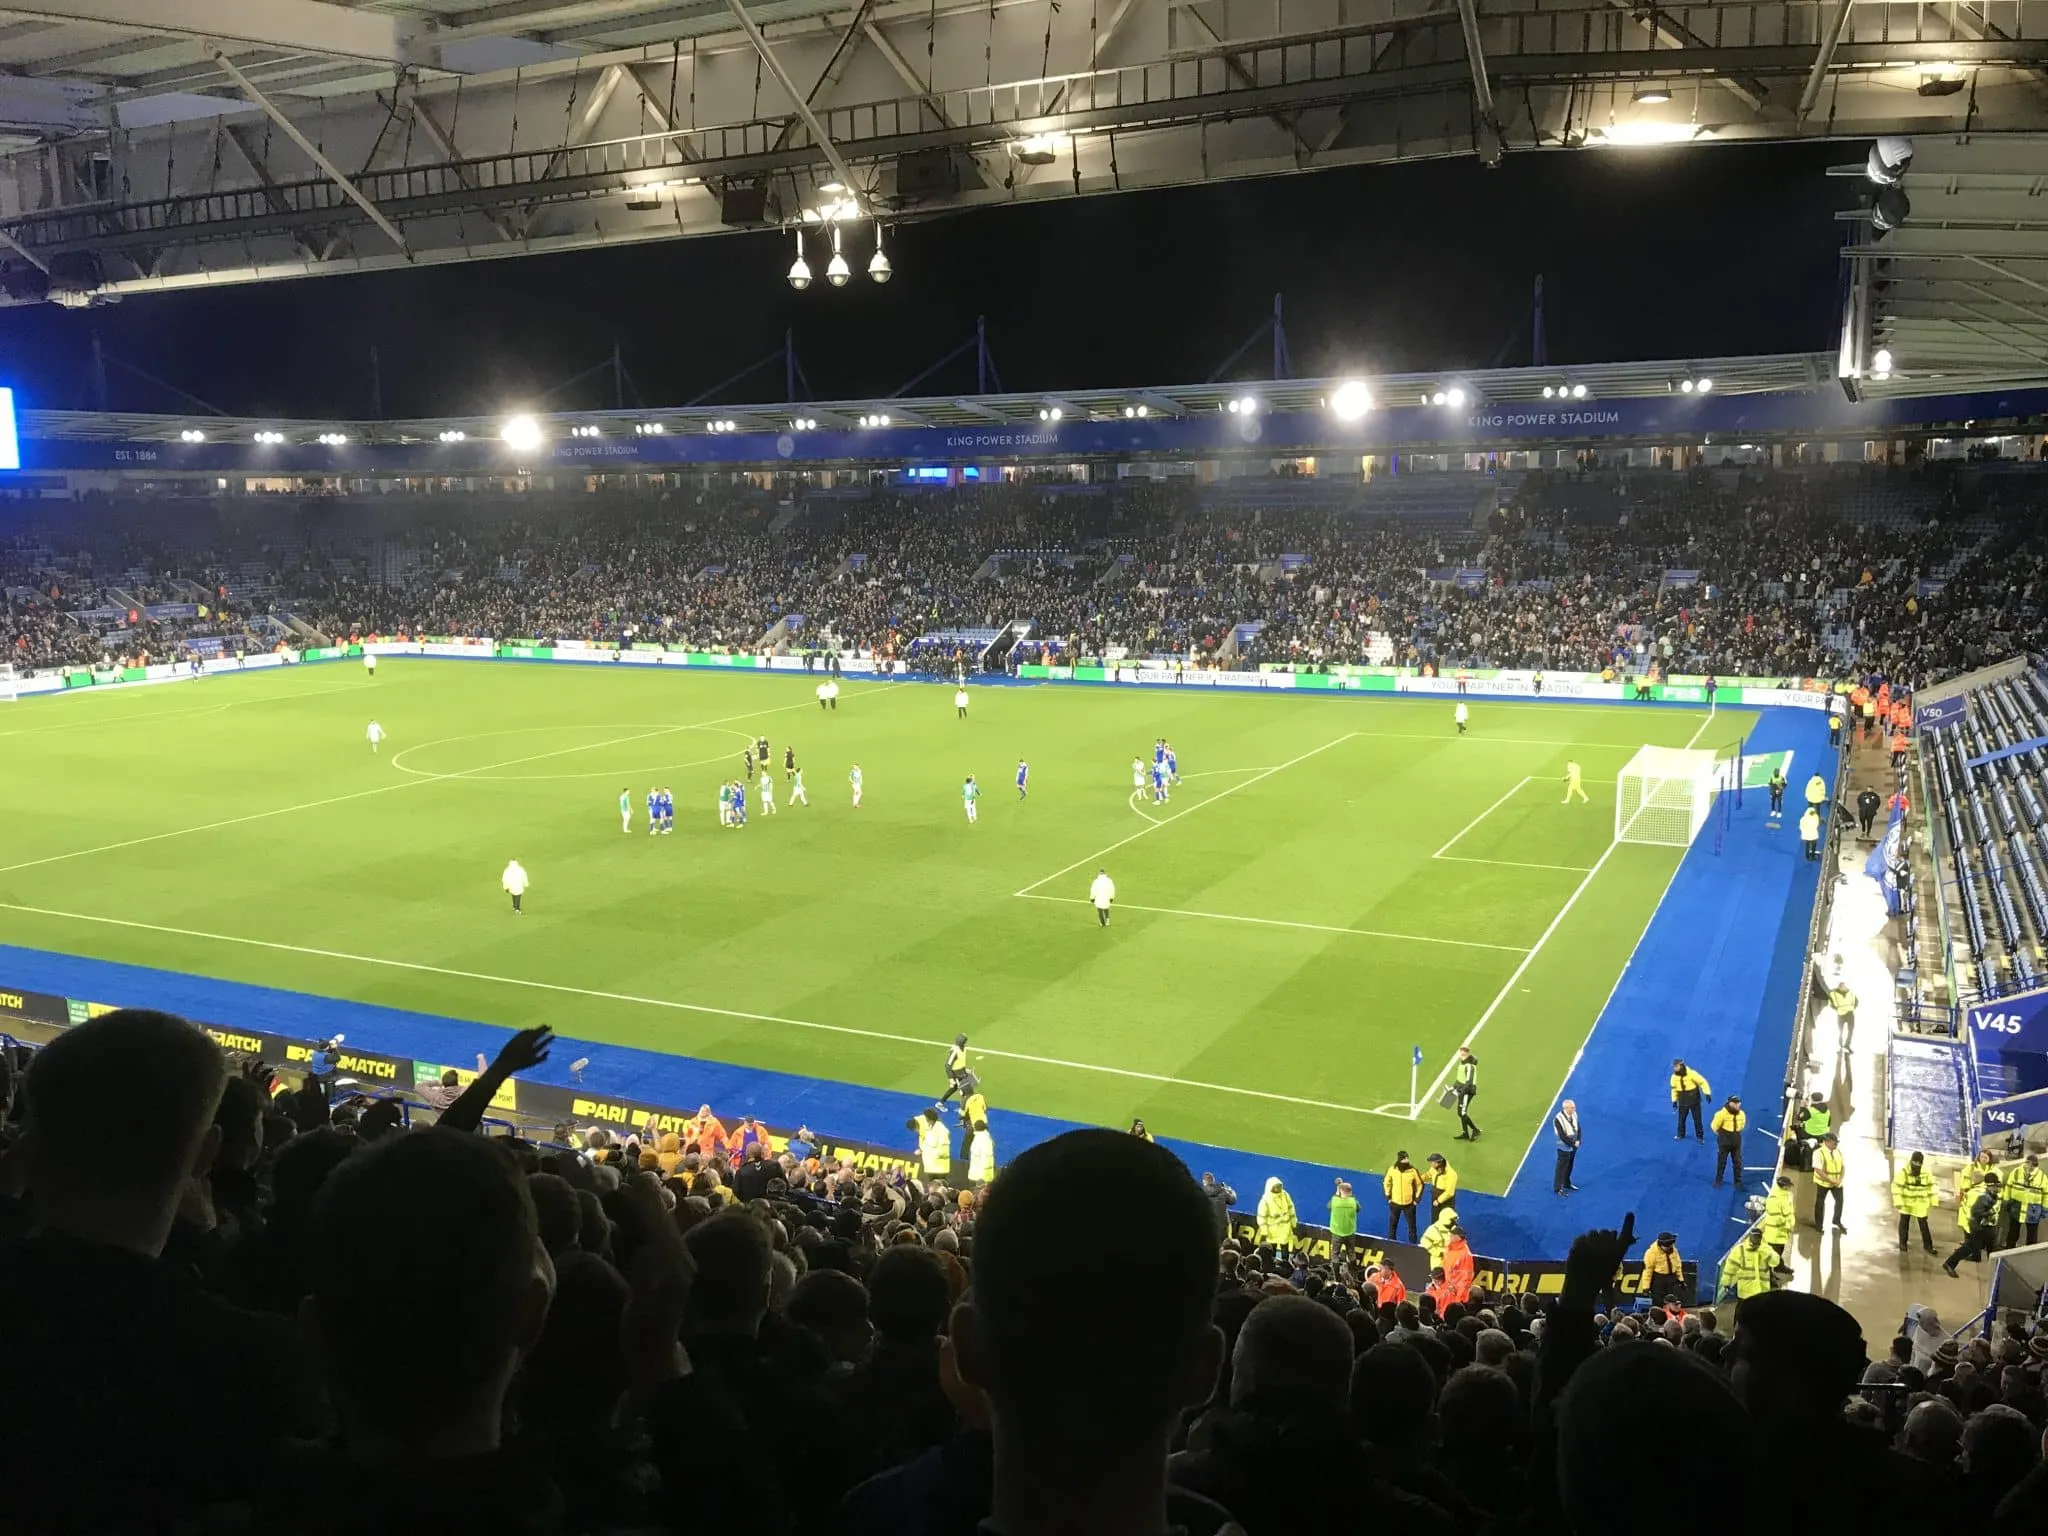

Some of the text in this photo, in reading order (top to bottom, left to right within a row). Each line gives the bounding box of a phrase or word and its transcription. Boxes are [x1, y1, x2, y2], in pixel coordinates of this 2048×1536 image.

[1468, 412, 1619, 427] KING POWER STADIUM
[947, 434, 1058, 447] KING POWER STADIUM
[115, 450, 157, 461] EST. 1884
[574, 446, 601, 456] POWER
[604, 445, 638, 455] STADIUM
[1162, 673, 1205, 682] PANER
[1921, 708, 1942, 718] V50
[1974, 1011, 2022, 1034] V45
[341, 1055, 397, 1079] MATCH
[583, 1100, 628, 1124] PARI
[1987, 1110, 2015, 1124] V45
[1289, 1234, 1384, 1267] MAH
[1473, 1270, 1530, 1294] ARI
